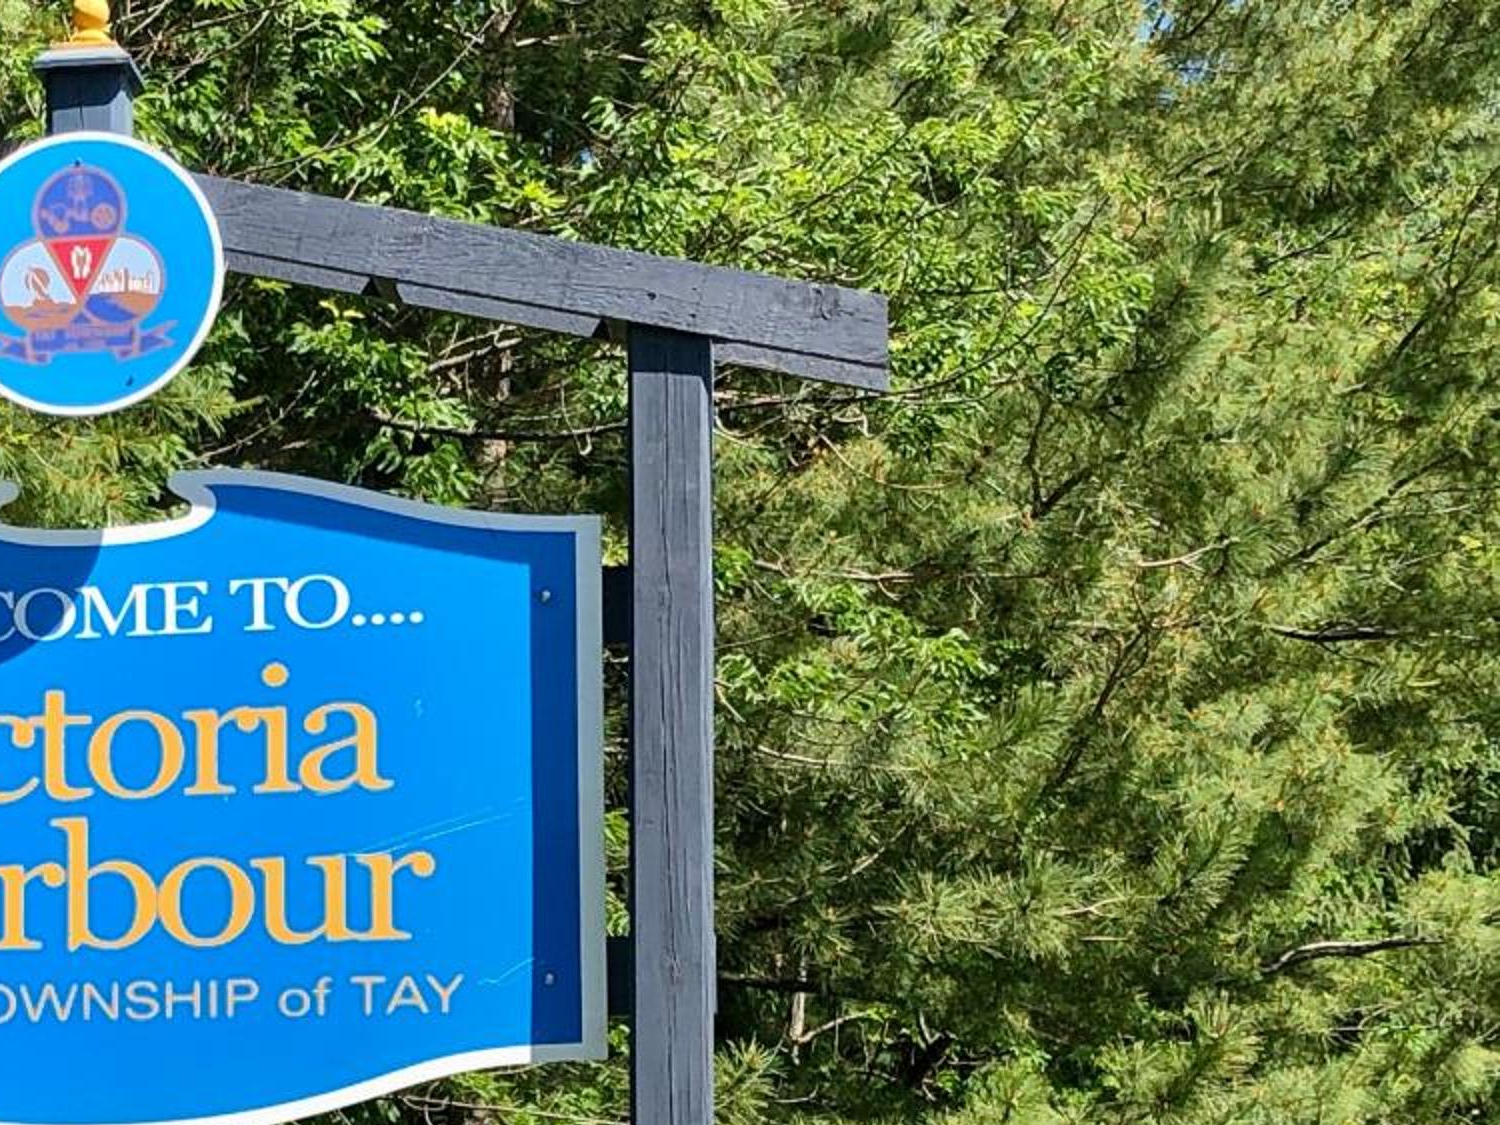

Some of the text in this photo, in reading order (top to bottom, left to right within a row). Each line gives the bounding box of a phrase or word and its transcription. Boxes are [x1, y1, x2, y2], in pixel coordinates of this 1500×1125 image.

[230, 574, 424, 631] TO....
[278, 976, 332, 1017] of
[350, 974, 464, 1015] TAY
